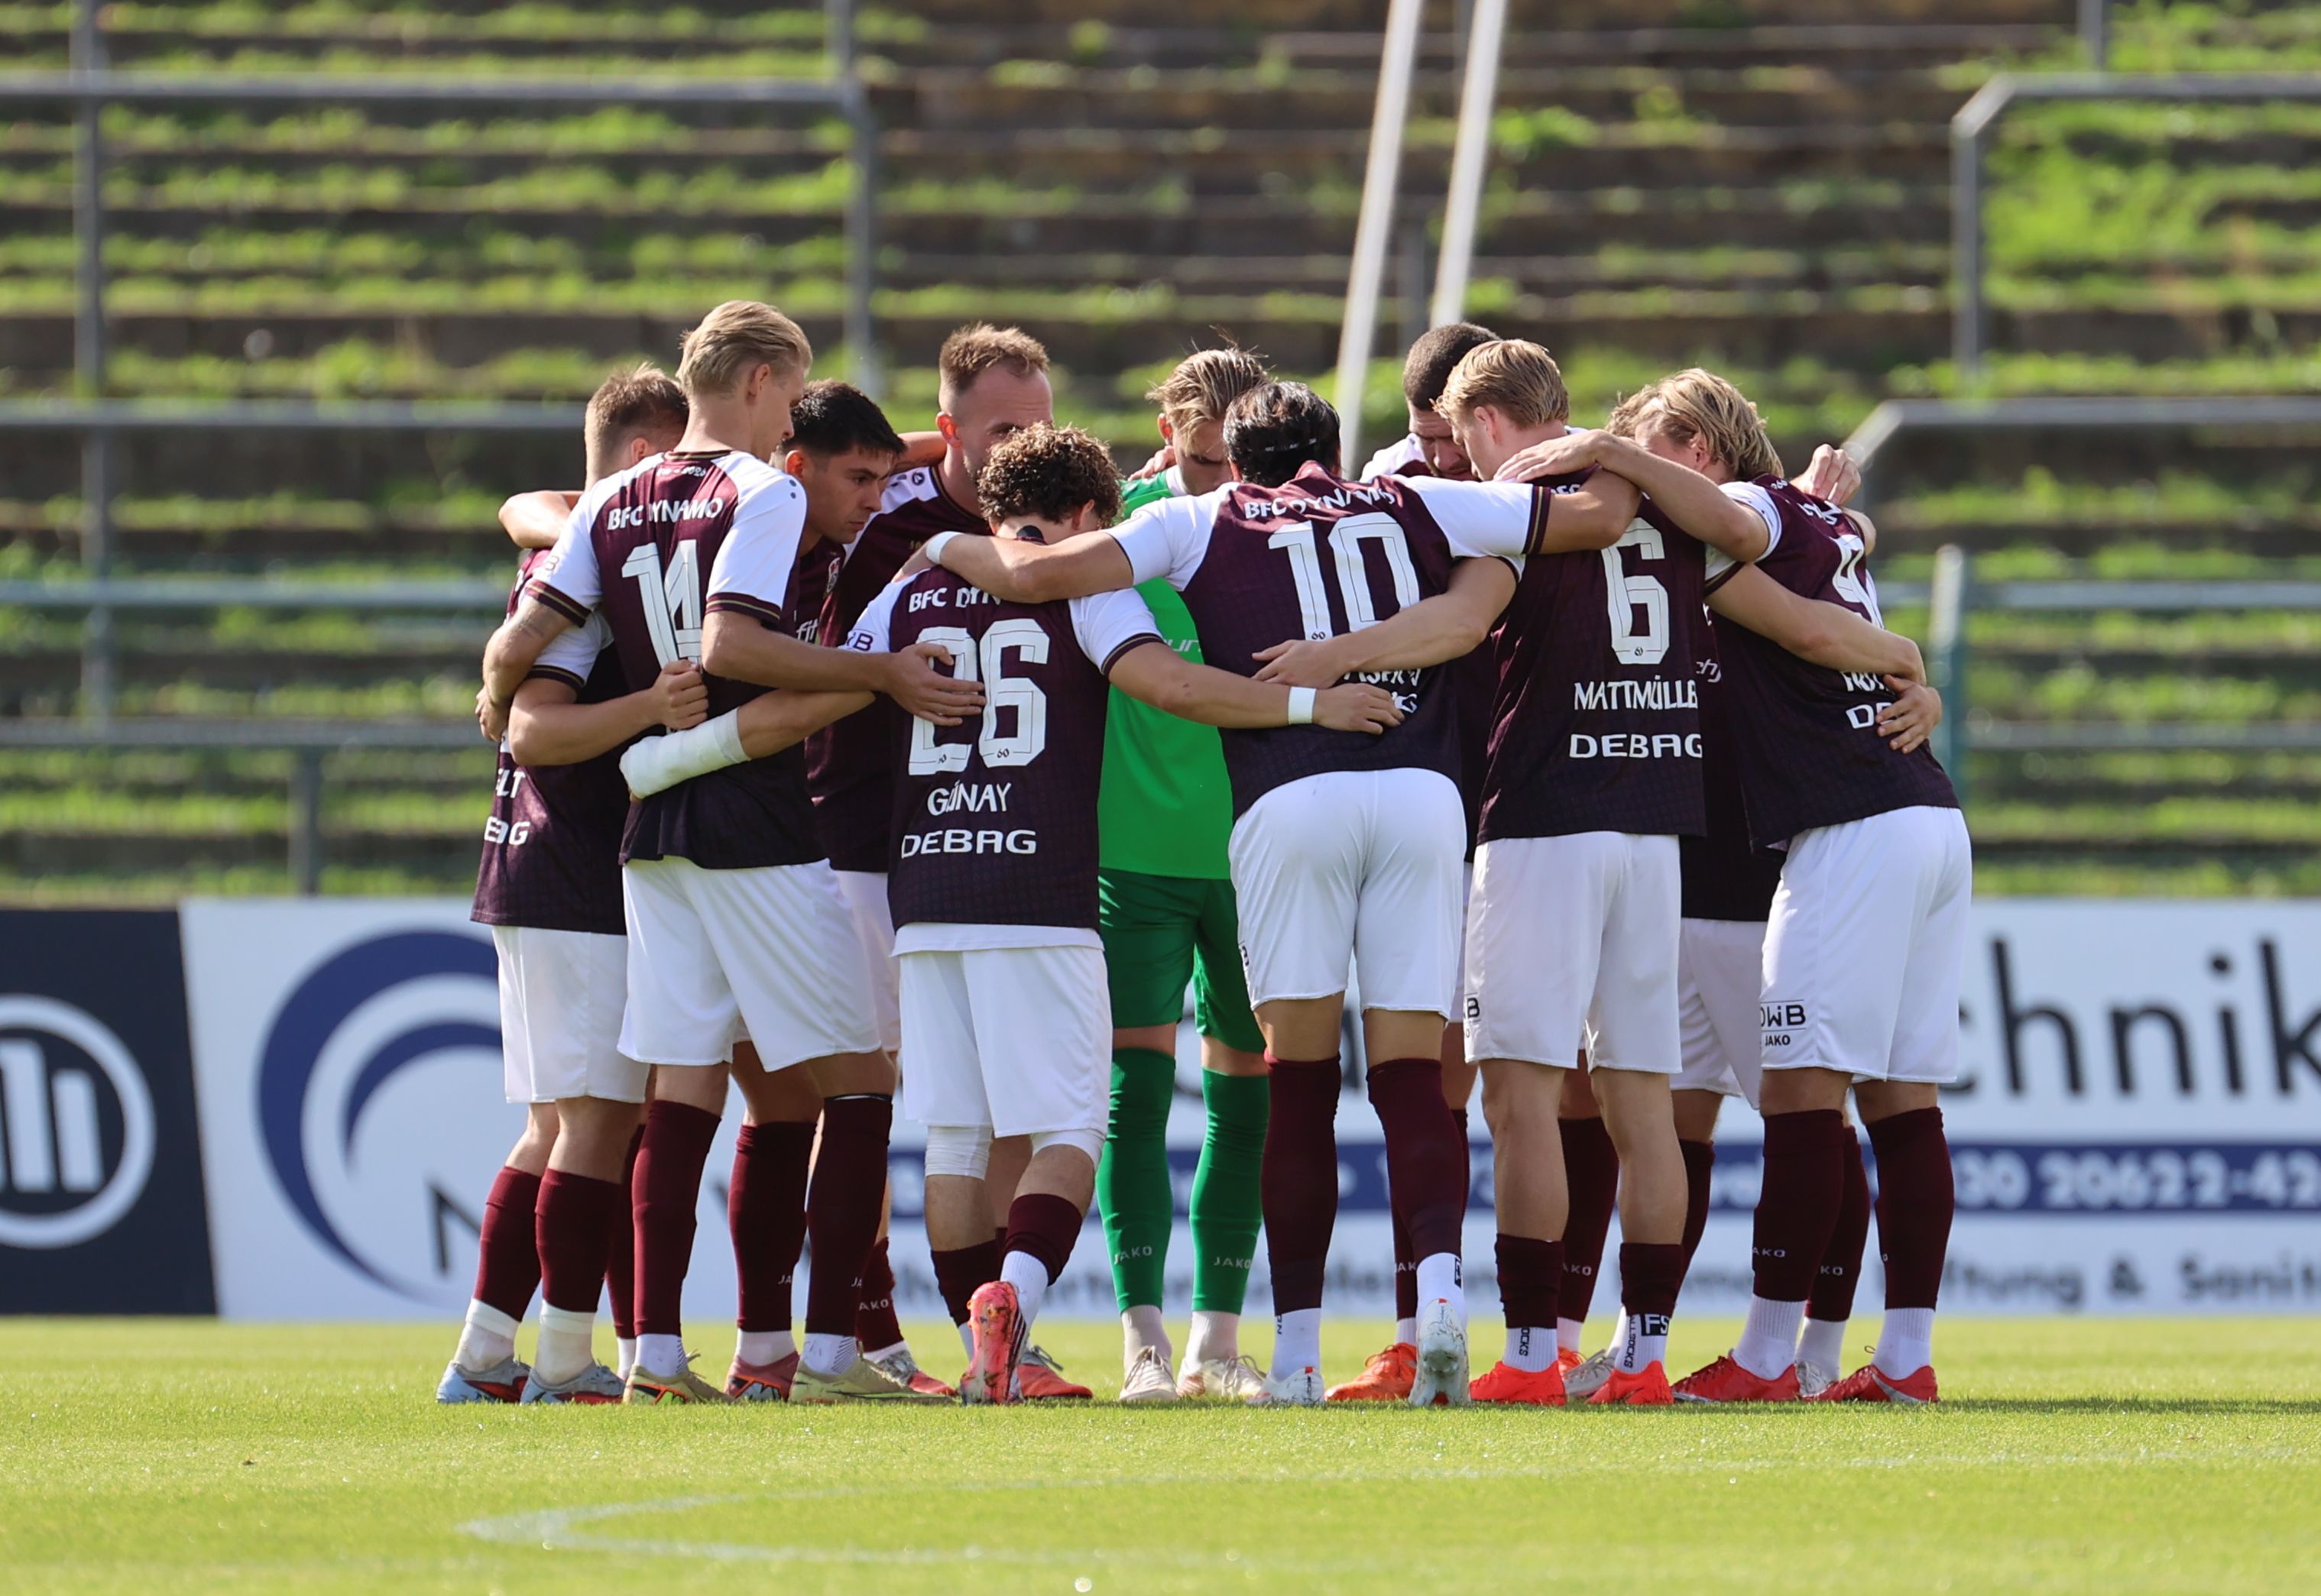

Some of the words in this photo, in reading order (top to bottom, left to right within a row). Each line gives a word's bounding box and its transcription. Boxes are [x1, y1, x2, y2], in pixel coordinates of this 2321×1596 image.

[608, 505, 644, 530] BFC
[1244, 497, 1286, 519] BFC
[1268, 512, 1420, 642] 10
[909, 587, 948, 613] BFC
[1601, 517, 1669, 665] 6
[621, 539, 702, 674] 14
[908, 618, 1050, 775] 26
[1569, 733, 1703, 759] DEBAG
[901, 829, 1037, 859] DEBAG
[1765, 1034, 1791, 1046] JAKO
[1113, 1245, 1152, 1265] JAKO
[1213, 1256, 1252, 1269] JAKO
[1752, 1247, 1786, 1258] AKO
[858, 1299, 890, 1312] AKO
[1645, 1314, 1670, 1335] FS
